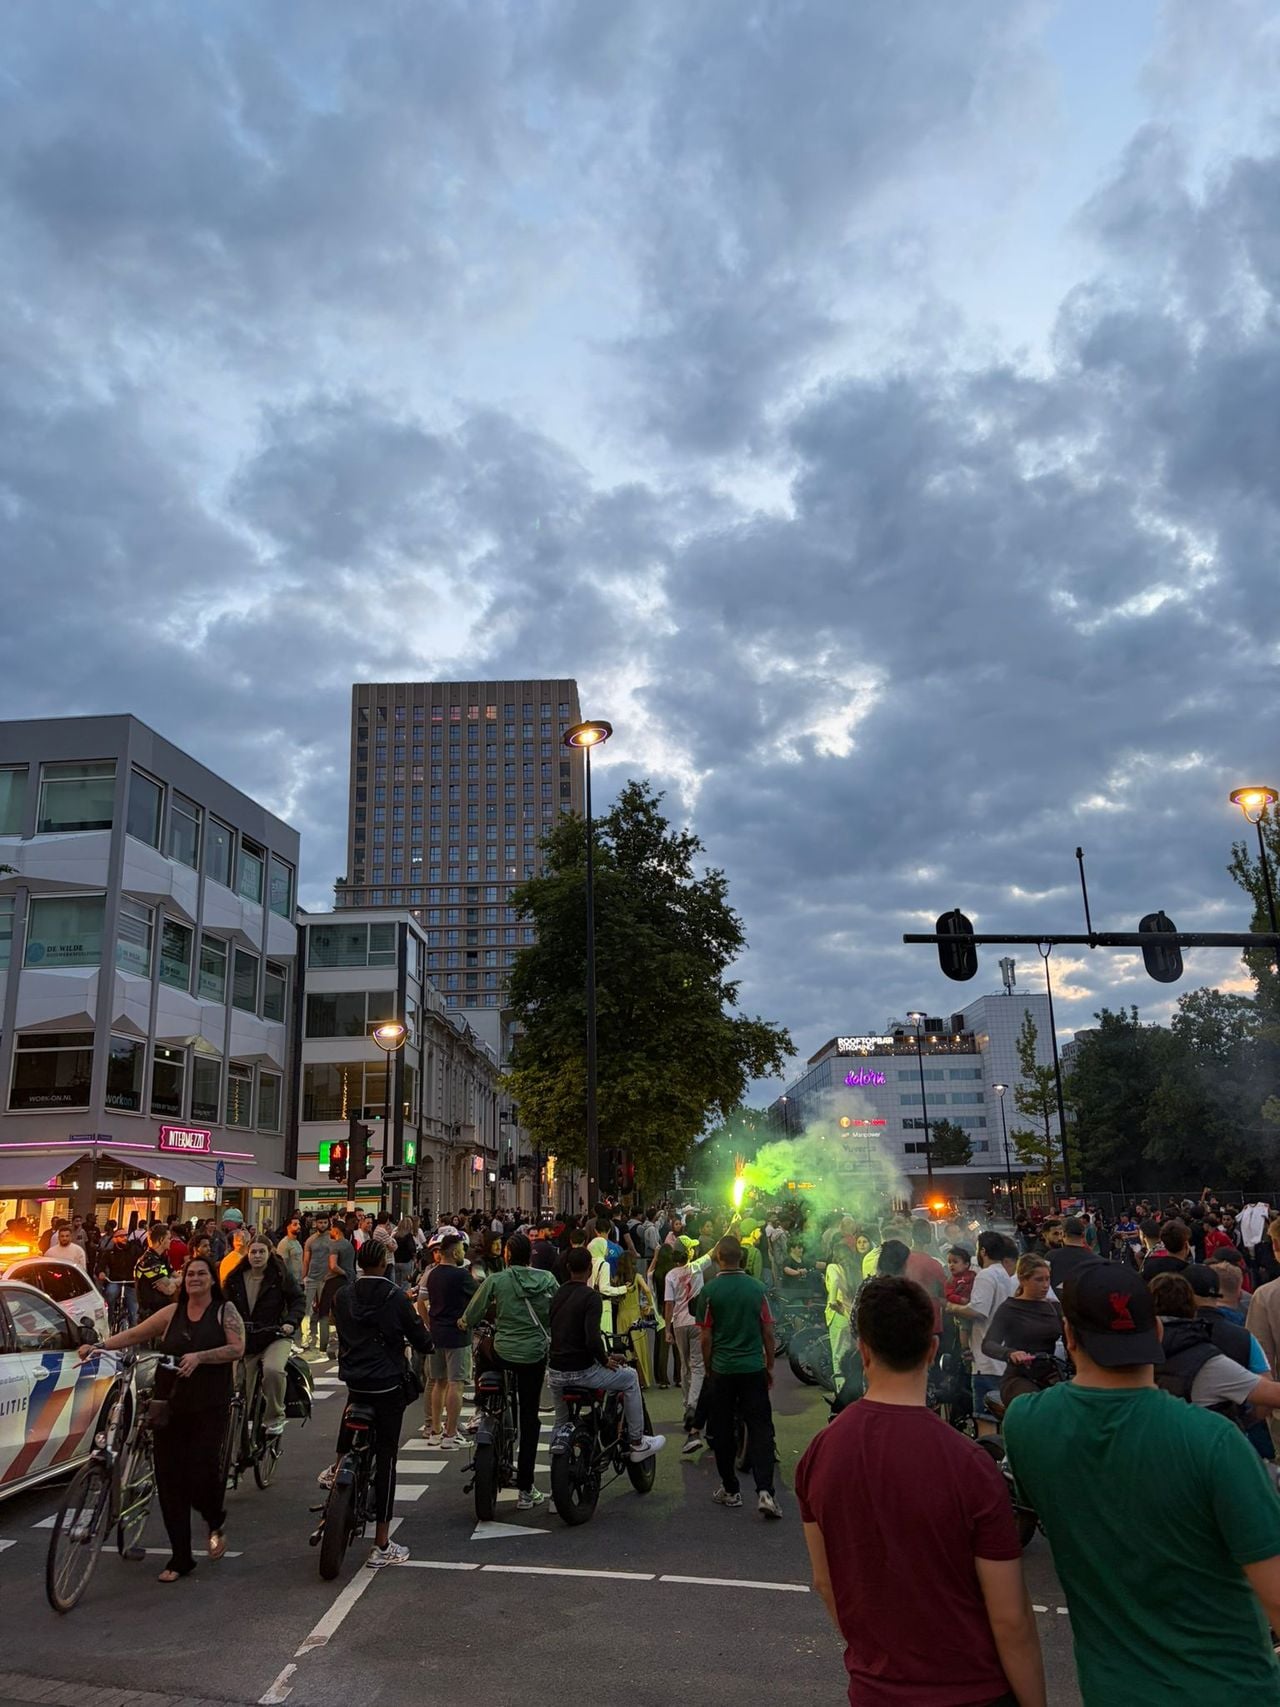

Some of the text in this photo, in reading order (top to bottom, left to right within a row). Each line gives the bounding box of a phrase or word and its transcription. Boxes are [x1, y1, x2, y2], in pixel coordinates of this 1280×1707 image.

[59, 944, 84, 952] WILDE
[837, 1037, 894, 1045] ROOFTOPBAR
[168, 1130, 205, 1149] INTERMEZZO
